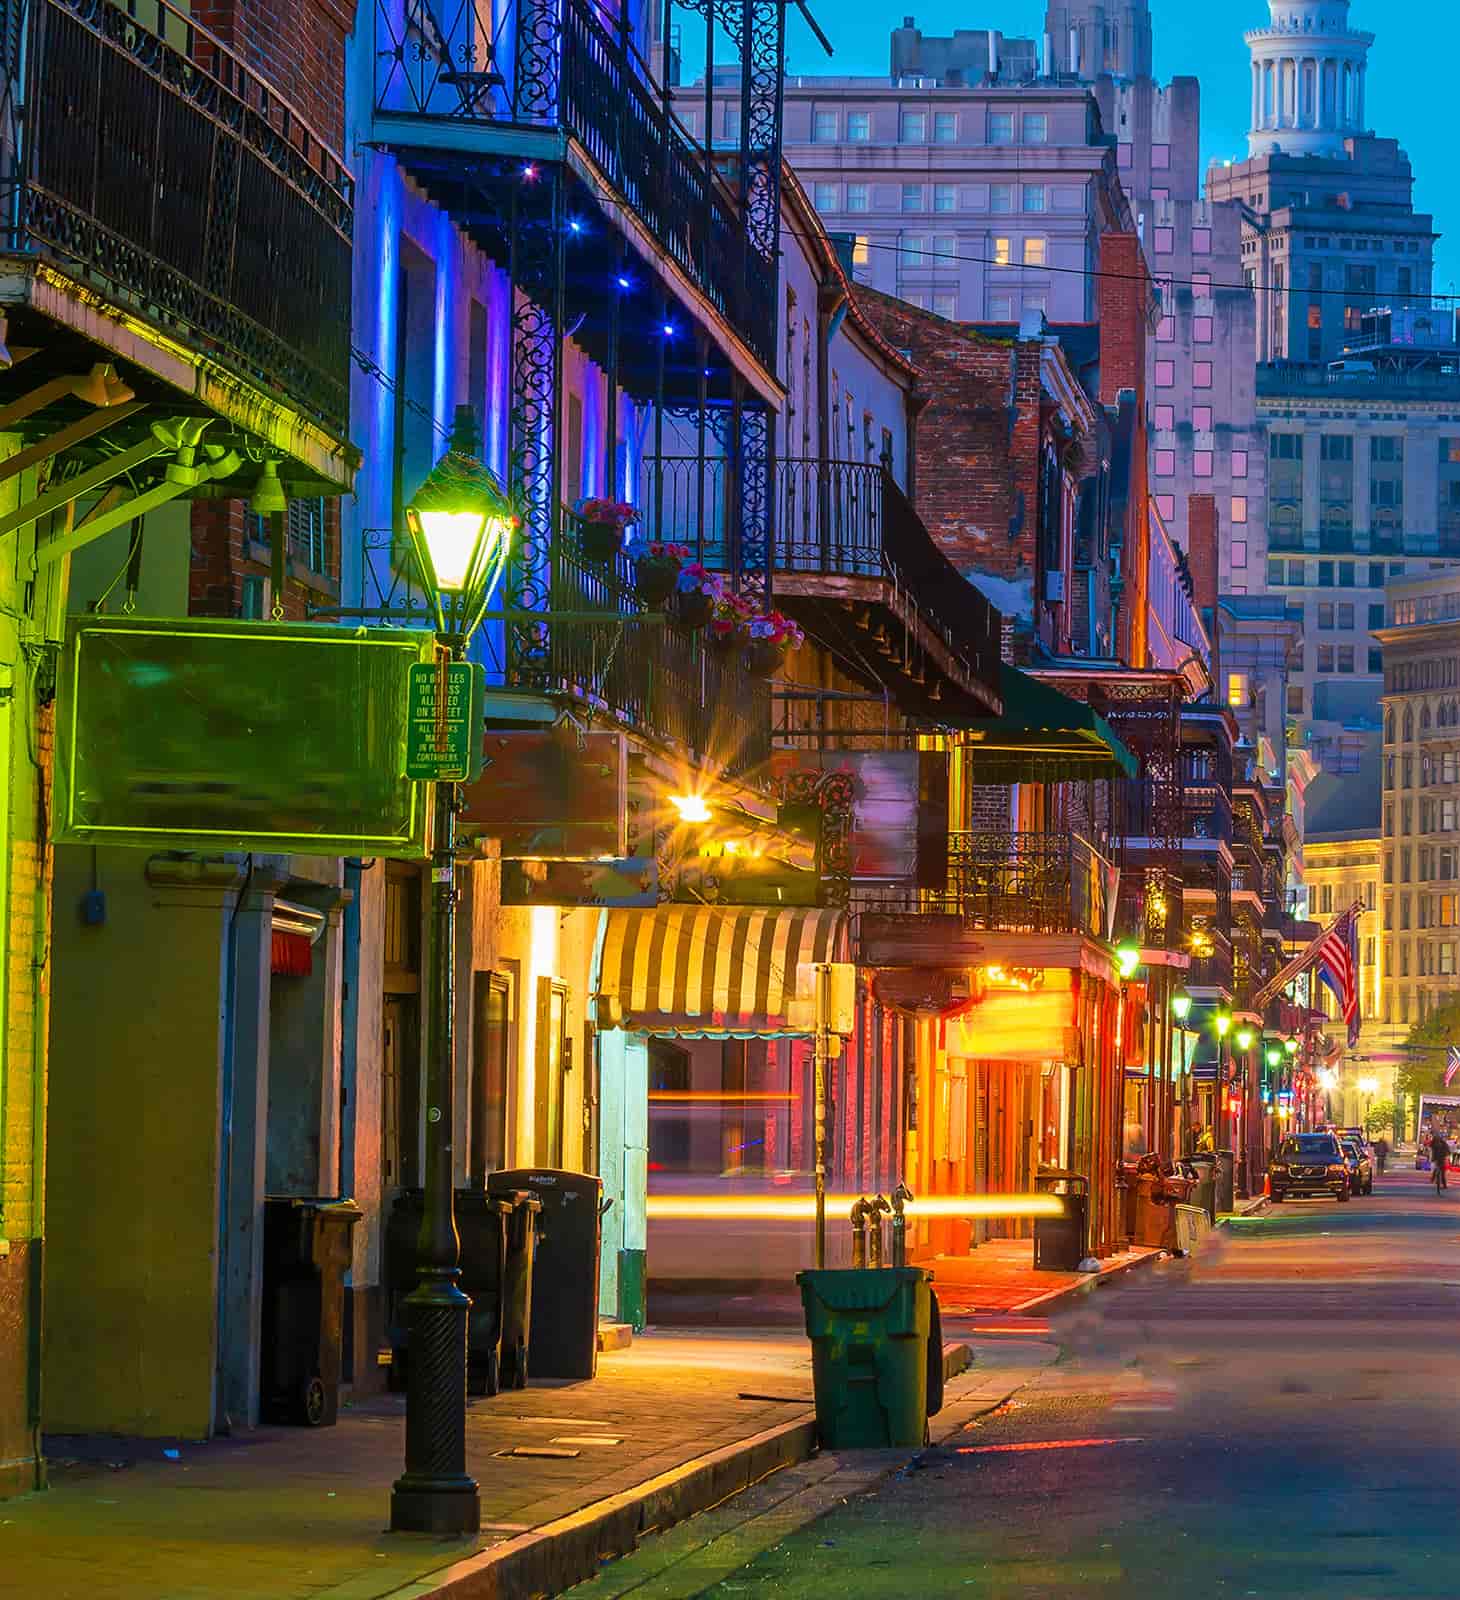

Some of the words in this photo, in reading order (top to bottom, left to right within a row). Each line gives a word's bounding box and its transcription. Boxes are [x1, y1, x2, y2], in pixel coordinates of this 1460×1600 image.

[416, 673, 427, 683] NO
[430, 673, 465, 684] BLES
[420, 685, 431, 695] OR
[421, 696, 458, 706] ALLED
[417, 707, 429, 717] ON
[431, 707, 461, 717] SEET
